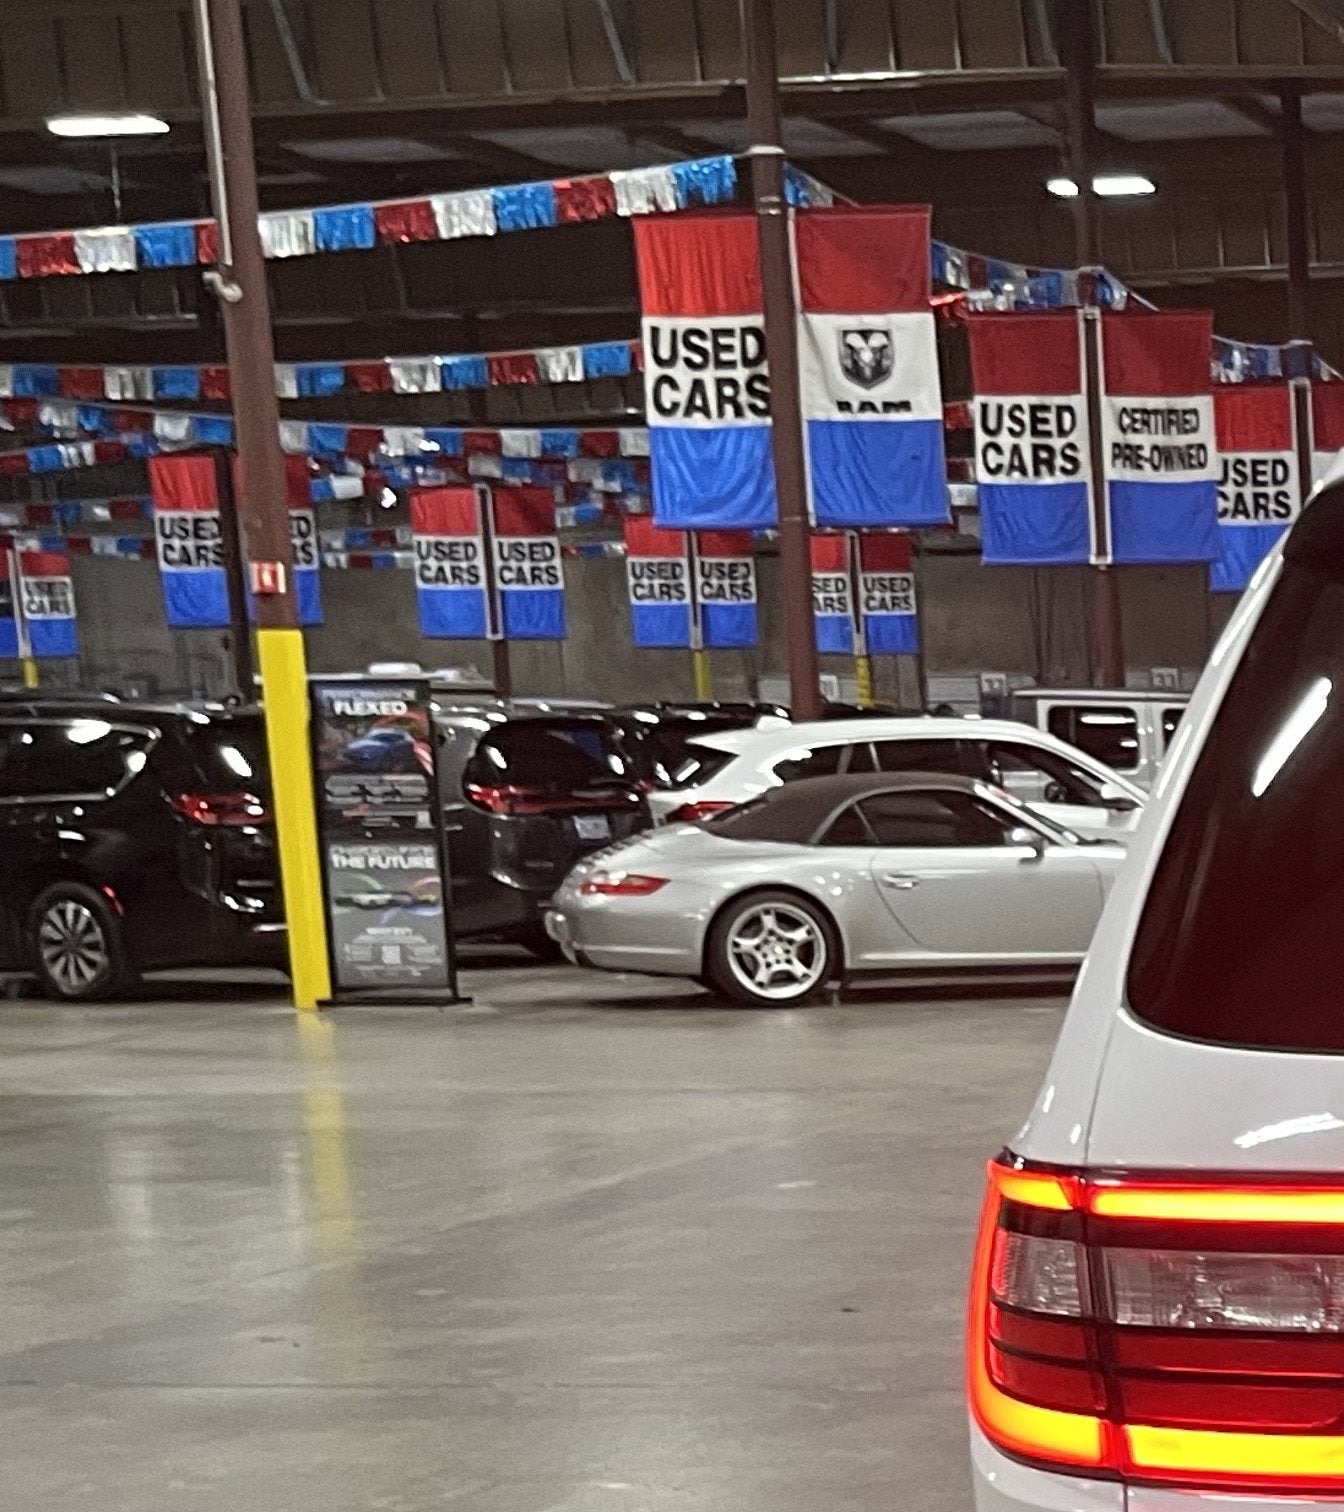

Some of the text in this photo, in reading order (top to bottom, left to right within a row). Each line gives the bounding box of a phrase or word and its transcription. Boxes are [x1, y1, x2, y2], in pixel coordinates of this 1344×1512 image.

[650, 325, 767, 371] USED
[652, 374, 771, 418] CARS
[980, 403, 1076, 438] USED
[1118, 407, 1200, 434] CERTIFIED
[981, 442, 1081, 477] CARS
[1111, 443, 1208, 472] PRE-OWNED
[417, 540, 478, 562] USED
[498, 541, 556, 562] USED
[419, 563, 480, 585] CARS
[500, 565, 559, 585] CARS
[631, 562, 684, 580] USED
[700, 561, 750, 580] USED
[632, 582, 687, 600] CARS
[701, 582, 751, 600] CARS
[863, 576, 911, 594] USED
[865, 596, 913, 613] CARS
